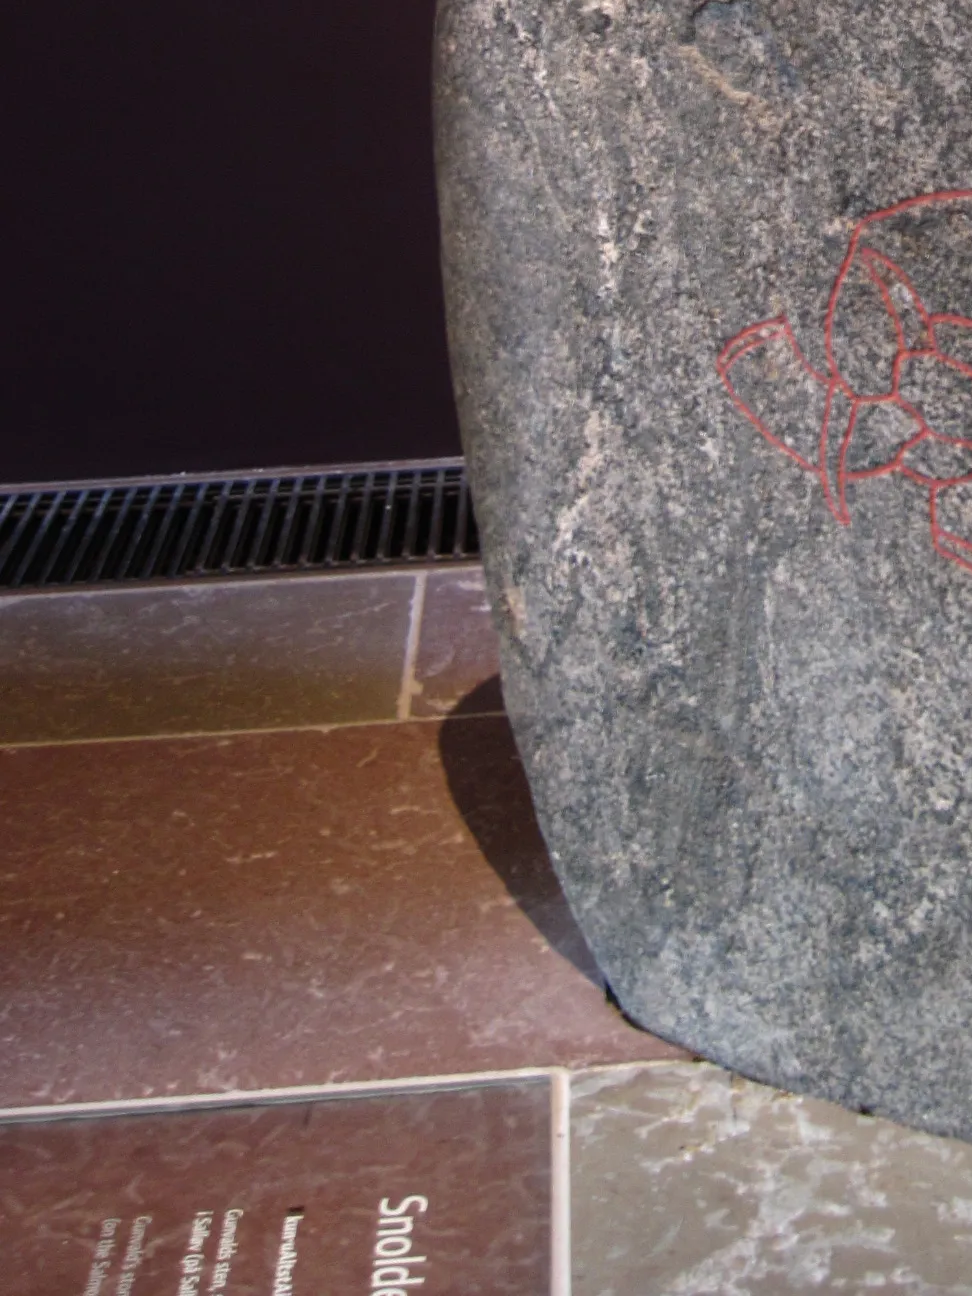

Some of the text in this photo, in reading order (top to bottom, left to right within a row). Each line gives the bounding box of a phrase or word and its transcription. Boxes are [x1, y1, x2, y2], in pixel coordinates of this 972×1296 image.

[94, 1238, 118, 1259] the
[121, 1217, 152, 1270] Gunvald's
[207, 1209, 244, 1291] Gunvalds sten,
